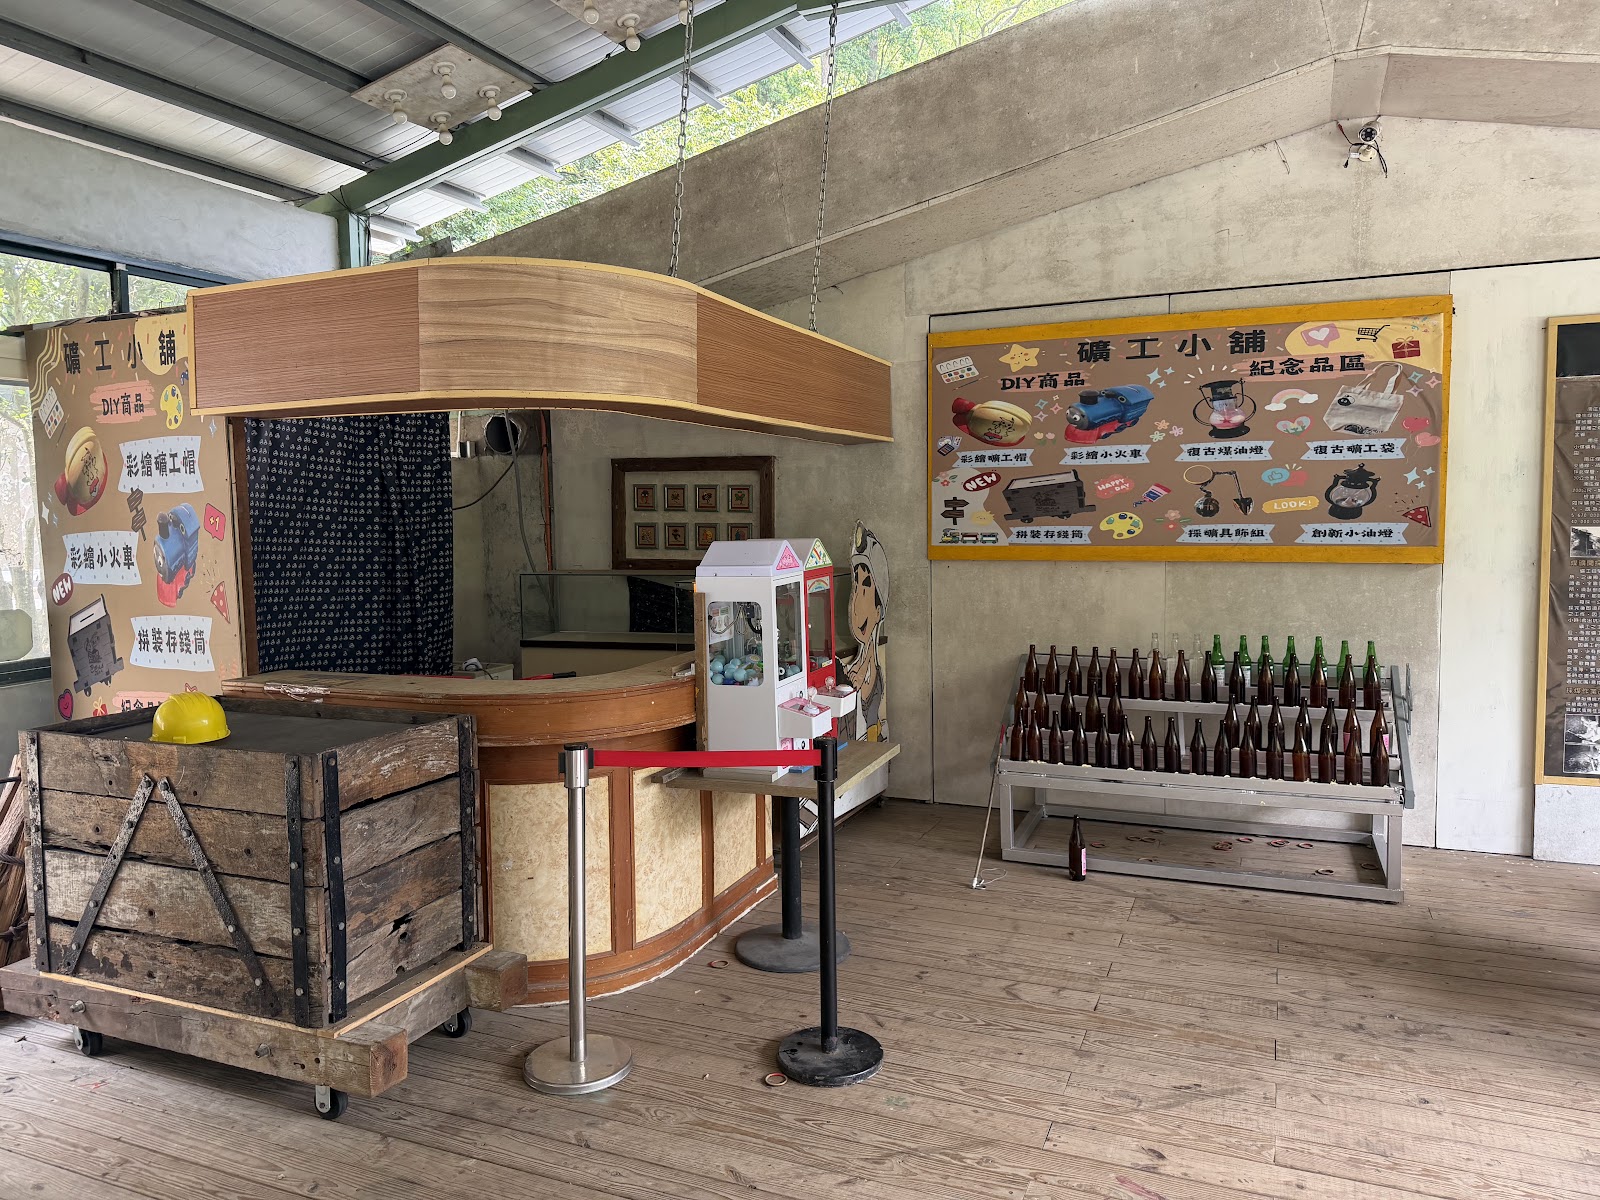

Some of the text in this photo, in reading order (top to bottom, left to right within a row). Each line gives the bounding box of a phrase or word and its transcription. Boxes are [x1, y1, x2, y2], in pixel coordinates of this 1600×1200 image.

[62, 330, 177, 375] 礦工小舖
[1076, 329, 1266, 363] 礦工小舖
[1249, 354, 1366, 377] 紀念品區
[1000, 372, 1085, 391] DIY商品
[101, 393, 145, 417] DIY商品
[960, 452, 1027, 464] 彩繪礦工帽
[1070, 448, 1143, 460] 彩繪小火車
[1186, 445, 1264, 457] 復古煤油燈
[1313, 442, 1395, 455] 復古礦工袋
[125, 450, 197, 478] 彩繪礦工帽
[964, 472, 998, 491] NEW
[1097, 478, 1125, 491] HAPPY
[1114, 483, 1130, 492] DAY
[1273, 499, 1313, 511] LOOK!
[1015, 529, 1083, 539] 拼裝存錢筒
[1311, 528, 1394, 538] 創新小油燈
[69, 544, 135, 571] 彩繪小火車
[52, 576, 72, 604] NEW
[137, 626, 207, 656] 拼裝存錢筒
